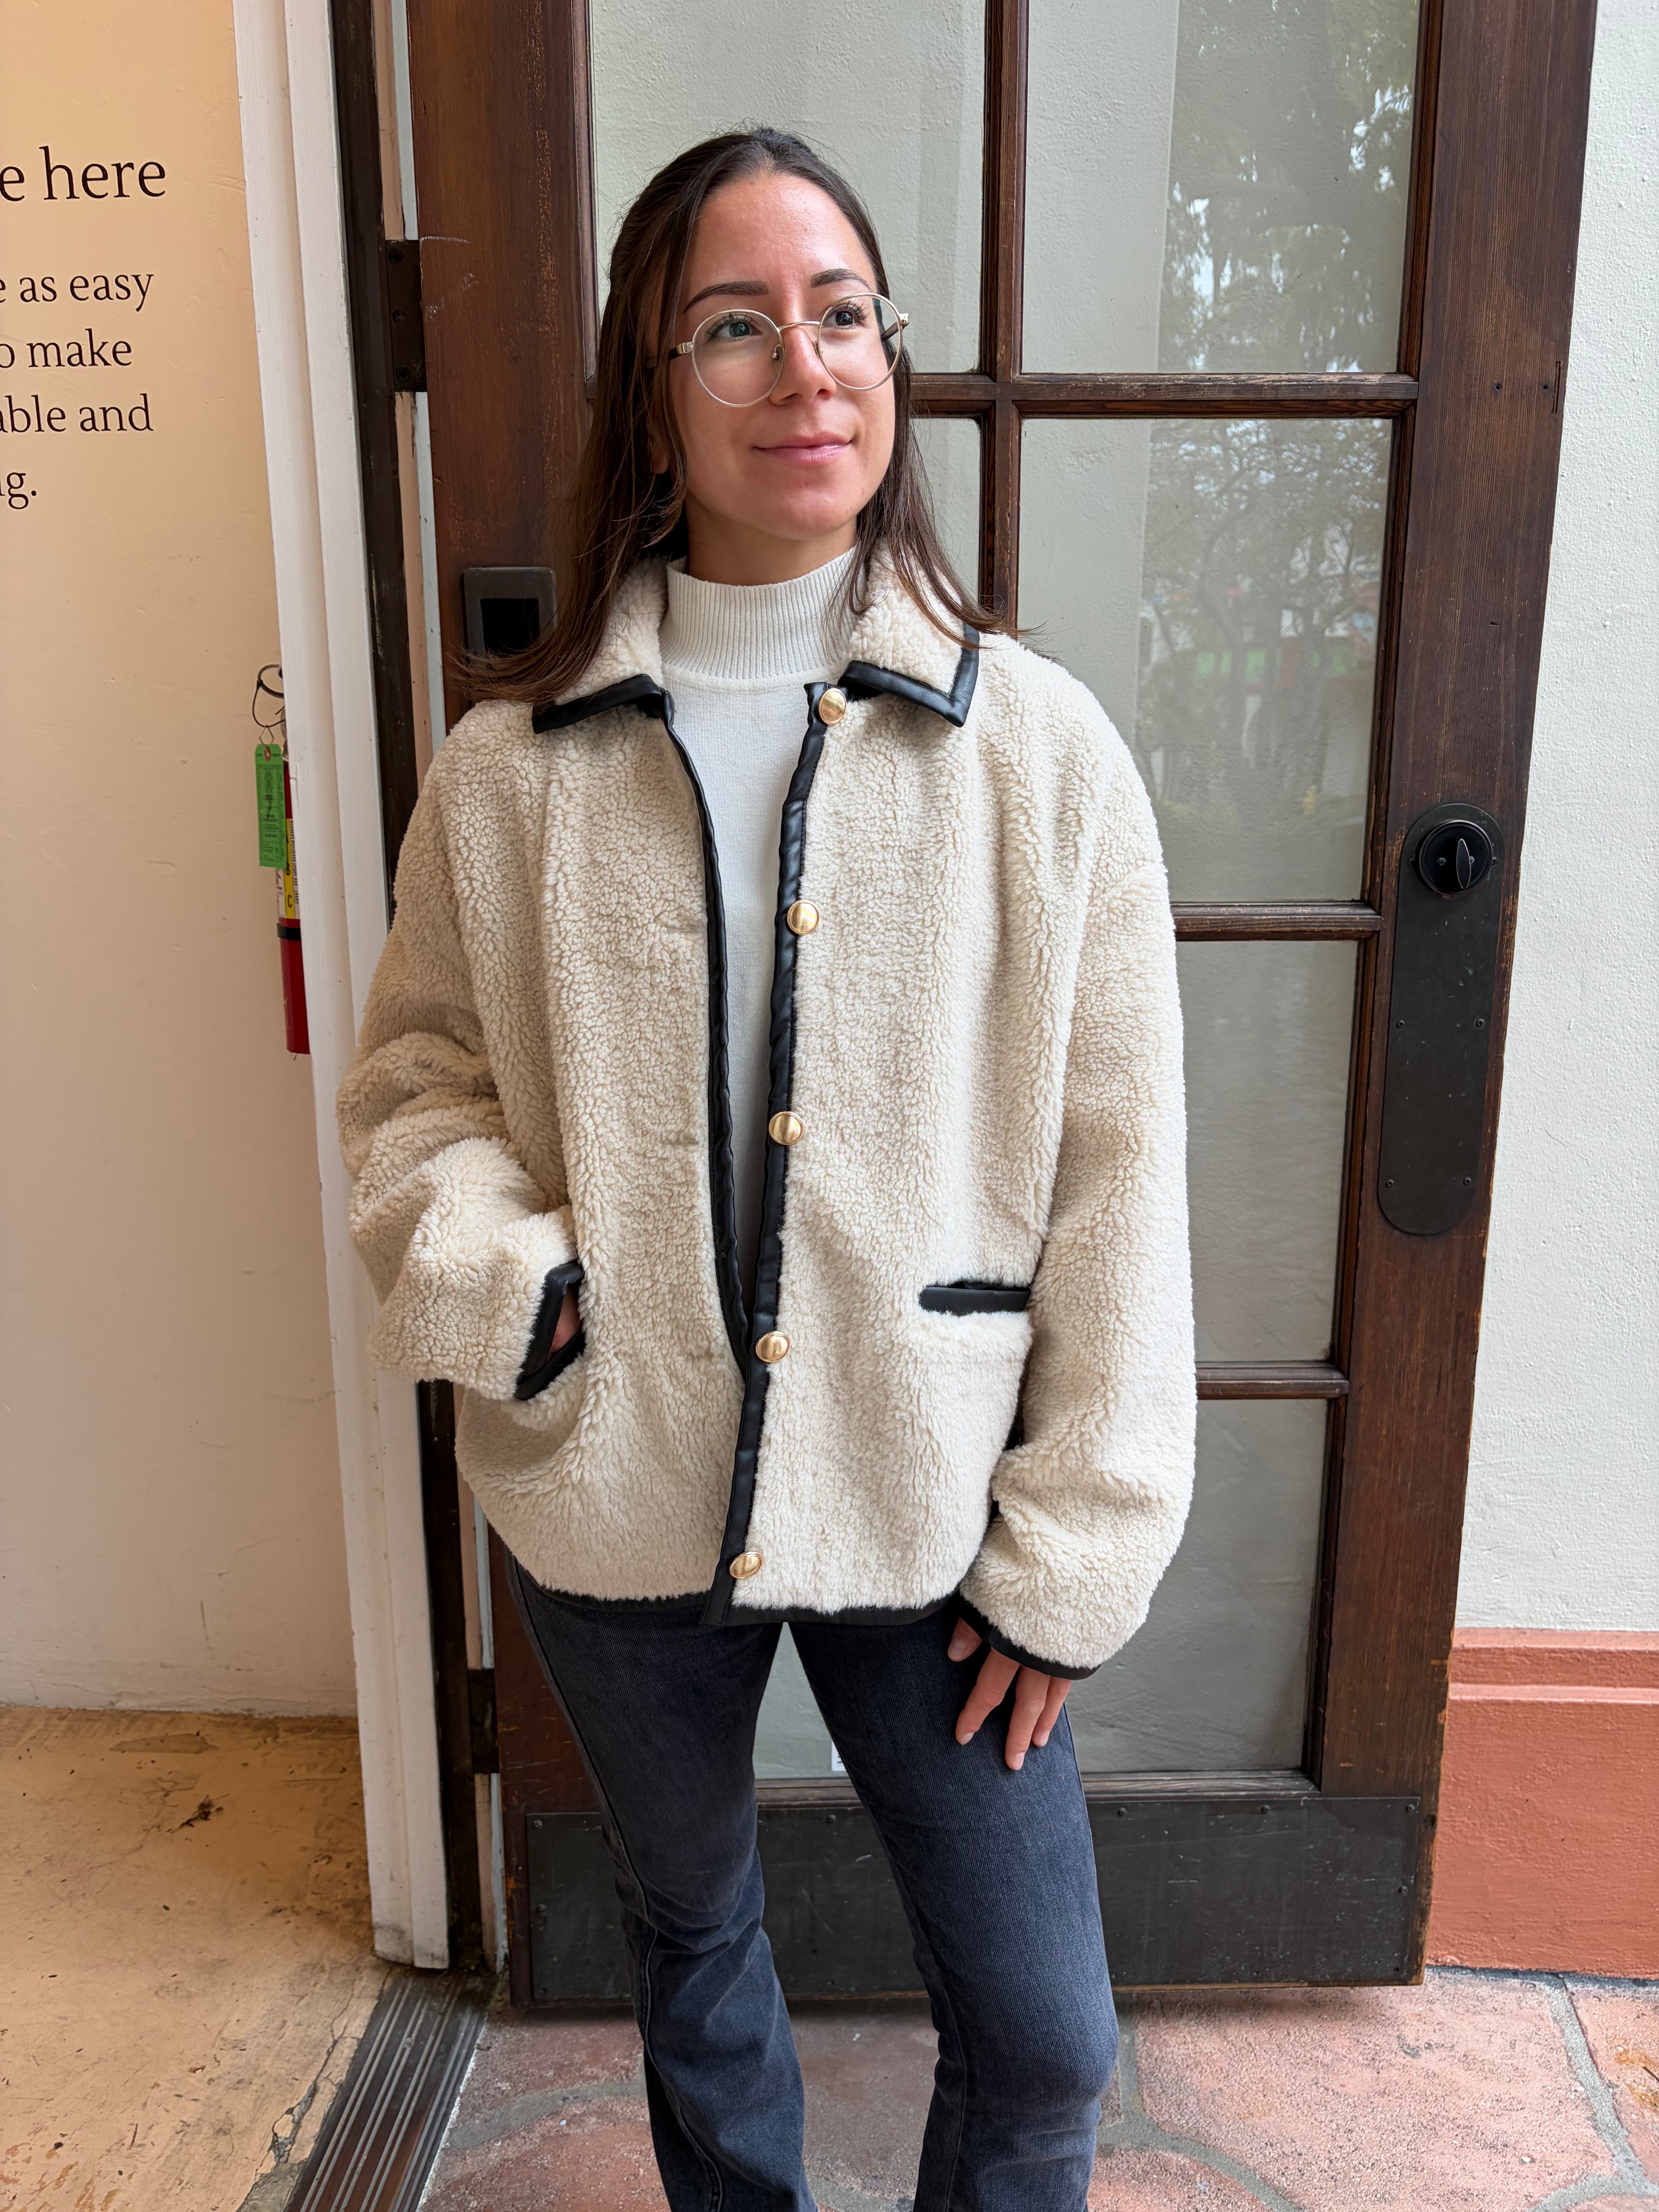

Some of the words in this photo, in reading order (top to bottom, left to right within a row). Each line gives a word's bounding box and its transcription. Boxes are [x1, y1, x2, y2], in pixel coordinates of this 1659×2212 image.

[0, 166, 25, 202] e
[38, 145, 166, 200] here
[19, 276, 57, 303] as
[70, 274, 154, 312] easy
[26, 328, 132, 367] make
[79, 393, 154, 432] and
[0, 472, 37, 509] g.
